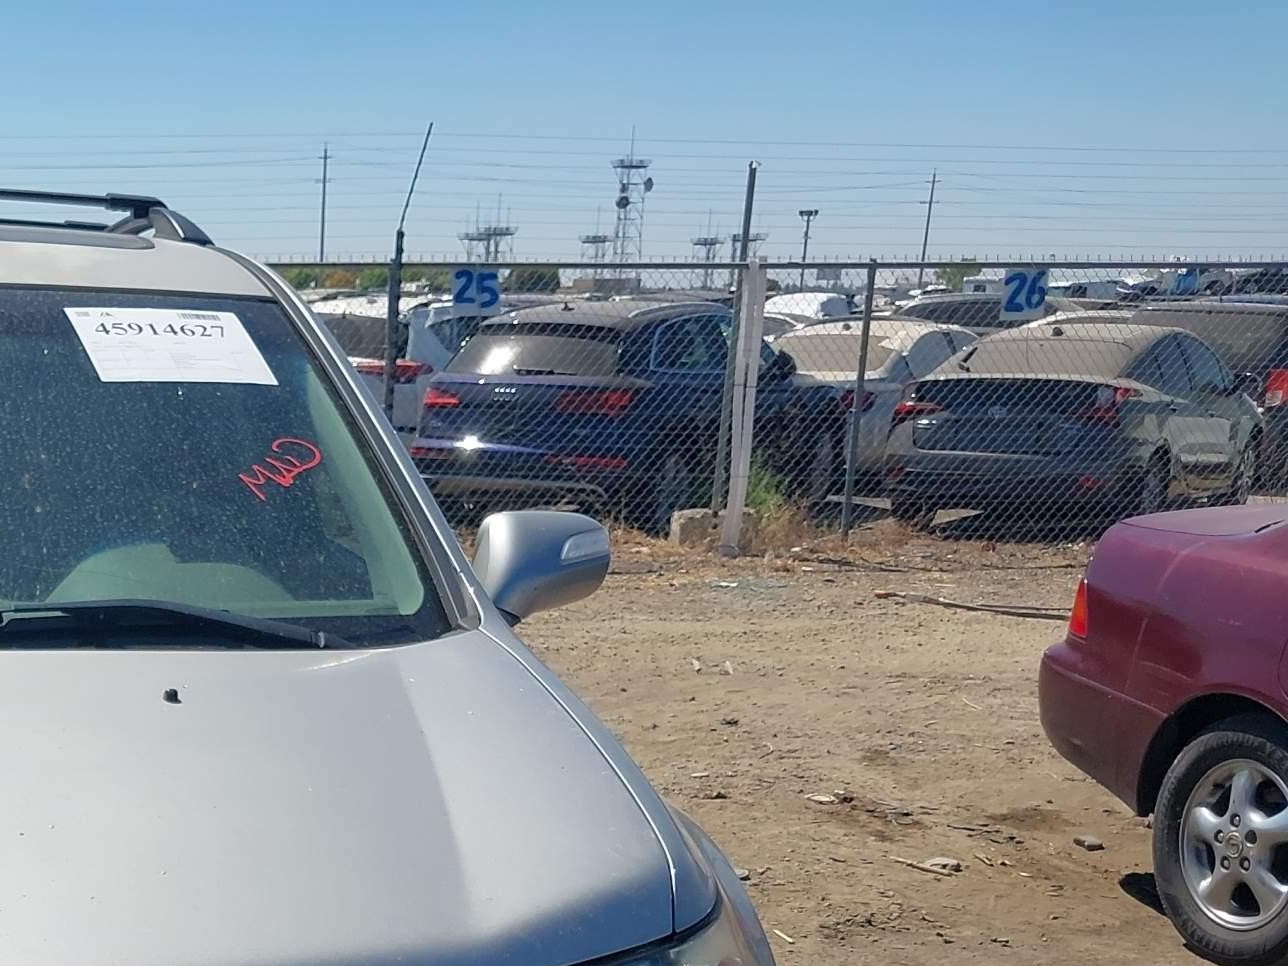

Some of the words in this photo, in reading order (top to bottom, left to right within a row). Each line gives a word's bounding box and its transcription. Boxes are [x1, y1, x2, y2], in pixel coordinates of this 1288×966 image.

[454, 269, 499, 308] 25
[1004, 270, 1048, 313] 26
[95, 322, 224, 338] 45914627
